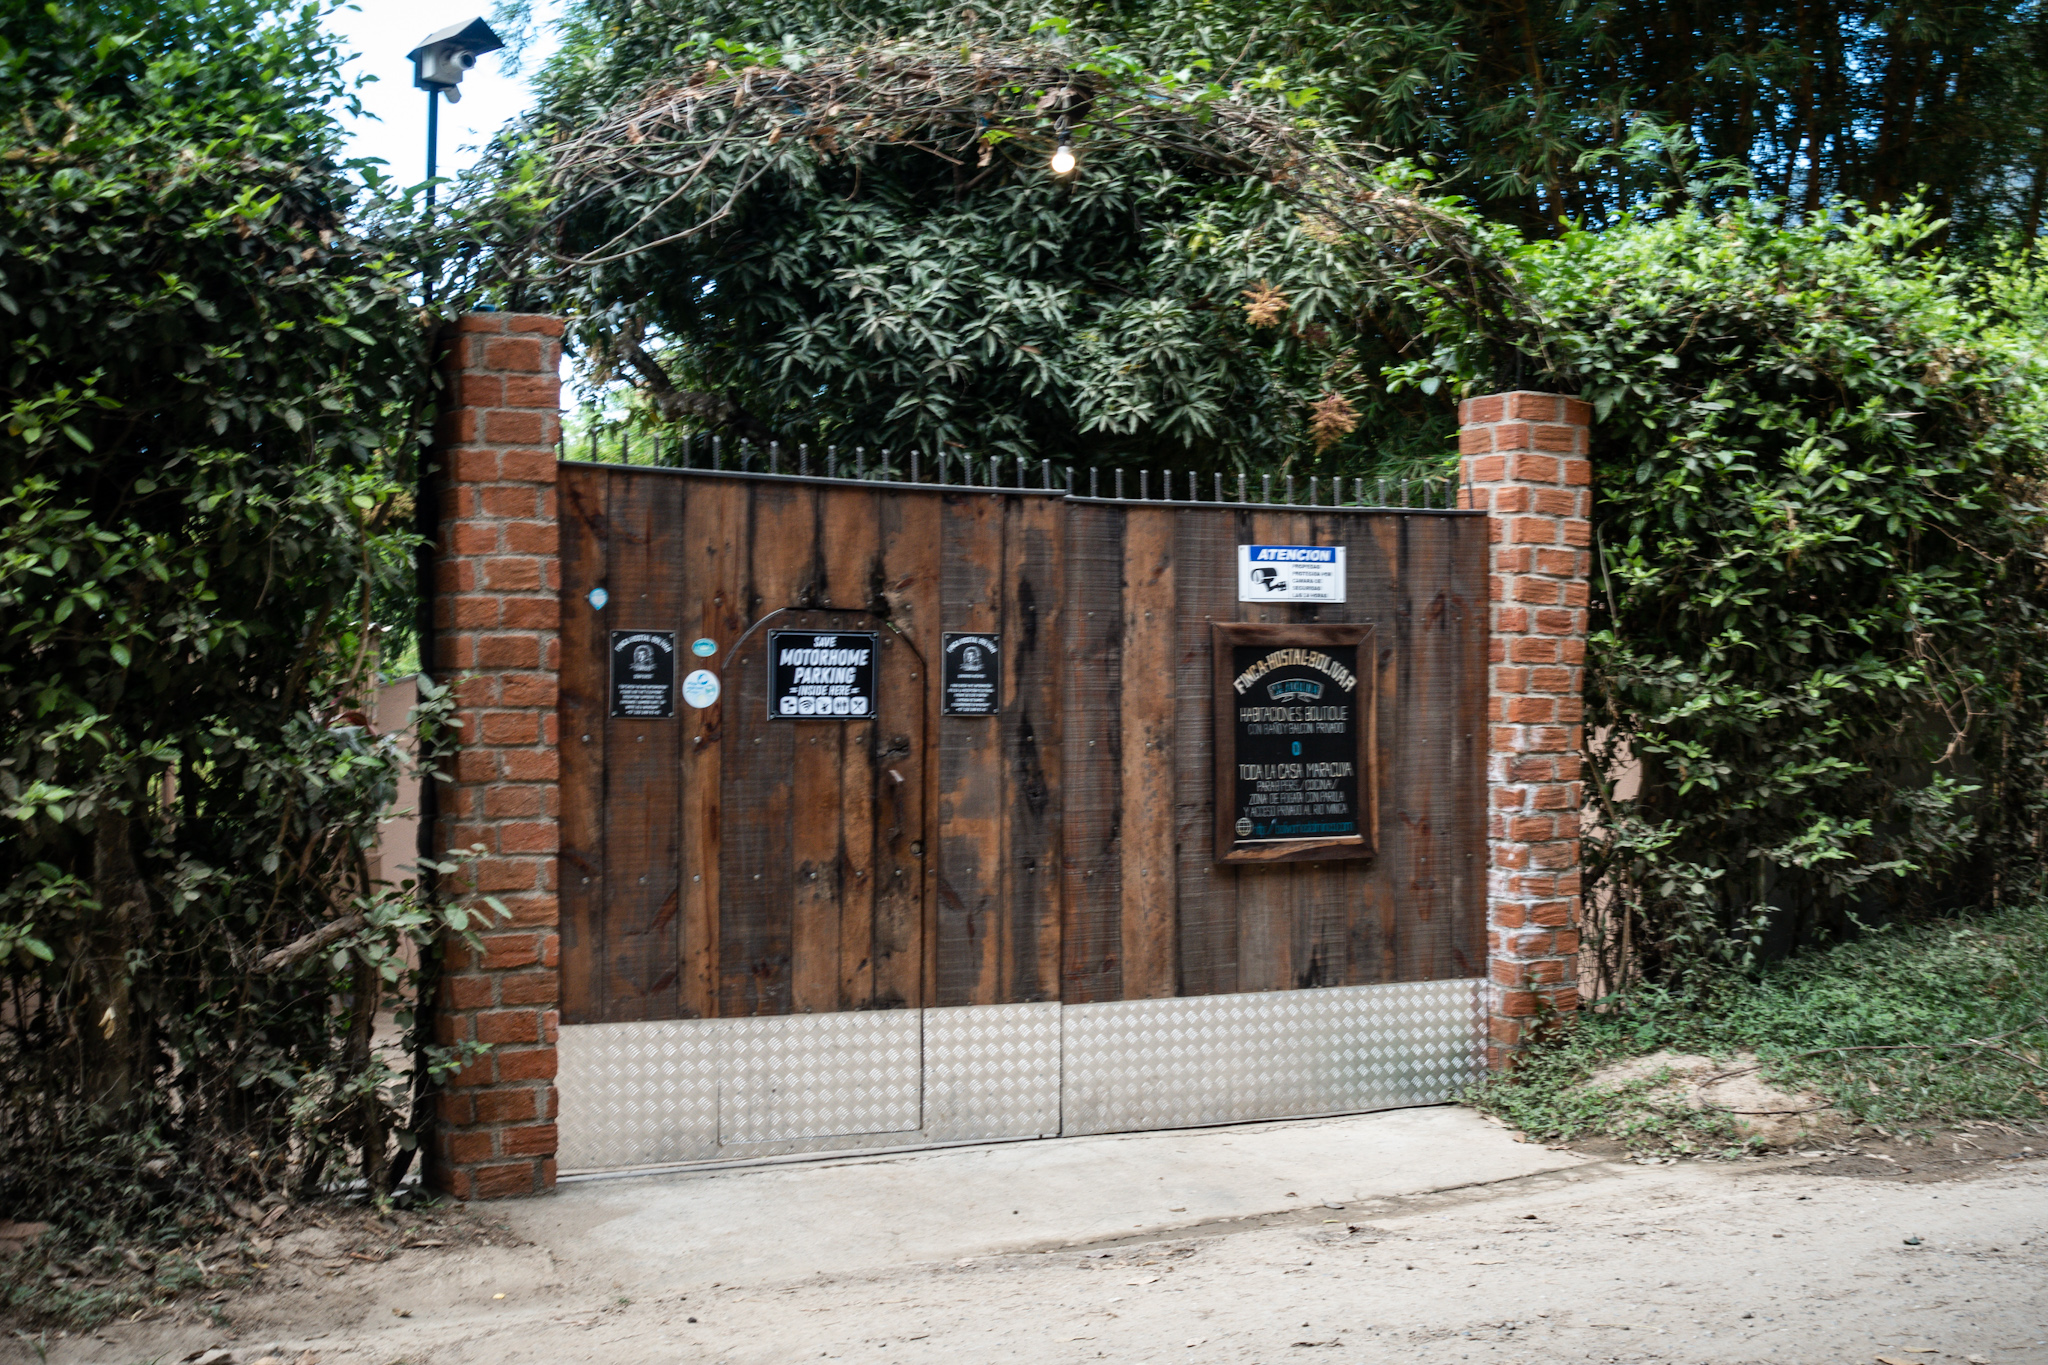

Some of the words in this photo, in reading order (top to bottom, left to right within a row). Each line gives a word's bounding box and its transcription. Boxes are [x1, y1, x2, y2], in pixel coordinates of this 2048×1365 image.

[1257, 549, 1332, 561] ATENCION
[813, 636, 838, 648] SAVE
[779, 648, 870, 666] MOTORHOME
[793, 667, 857, 684] PARKING
[797, 684, 829, 696] INSIDE
[828, 684, 853, 696] HERE
[1239, 706, 1304, 722] HABITACIONES
[1304, 705, 1349, 721] BOUTIQUE
[1247, 723, 1263, 735] CON
[1315, 722, 1347, 734] PRIVADO
[1238, 763, 1264, 780] TODA
[1264, 763, 1277, 779] LA
[1277, 763, 1304, 780] CASA
